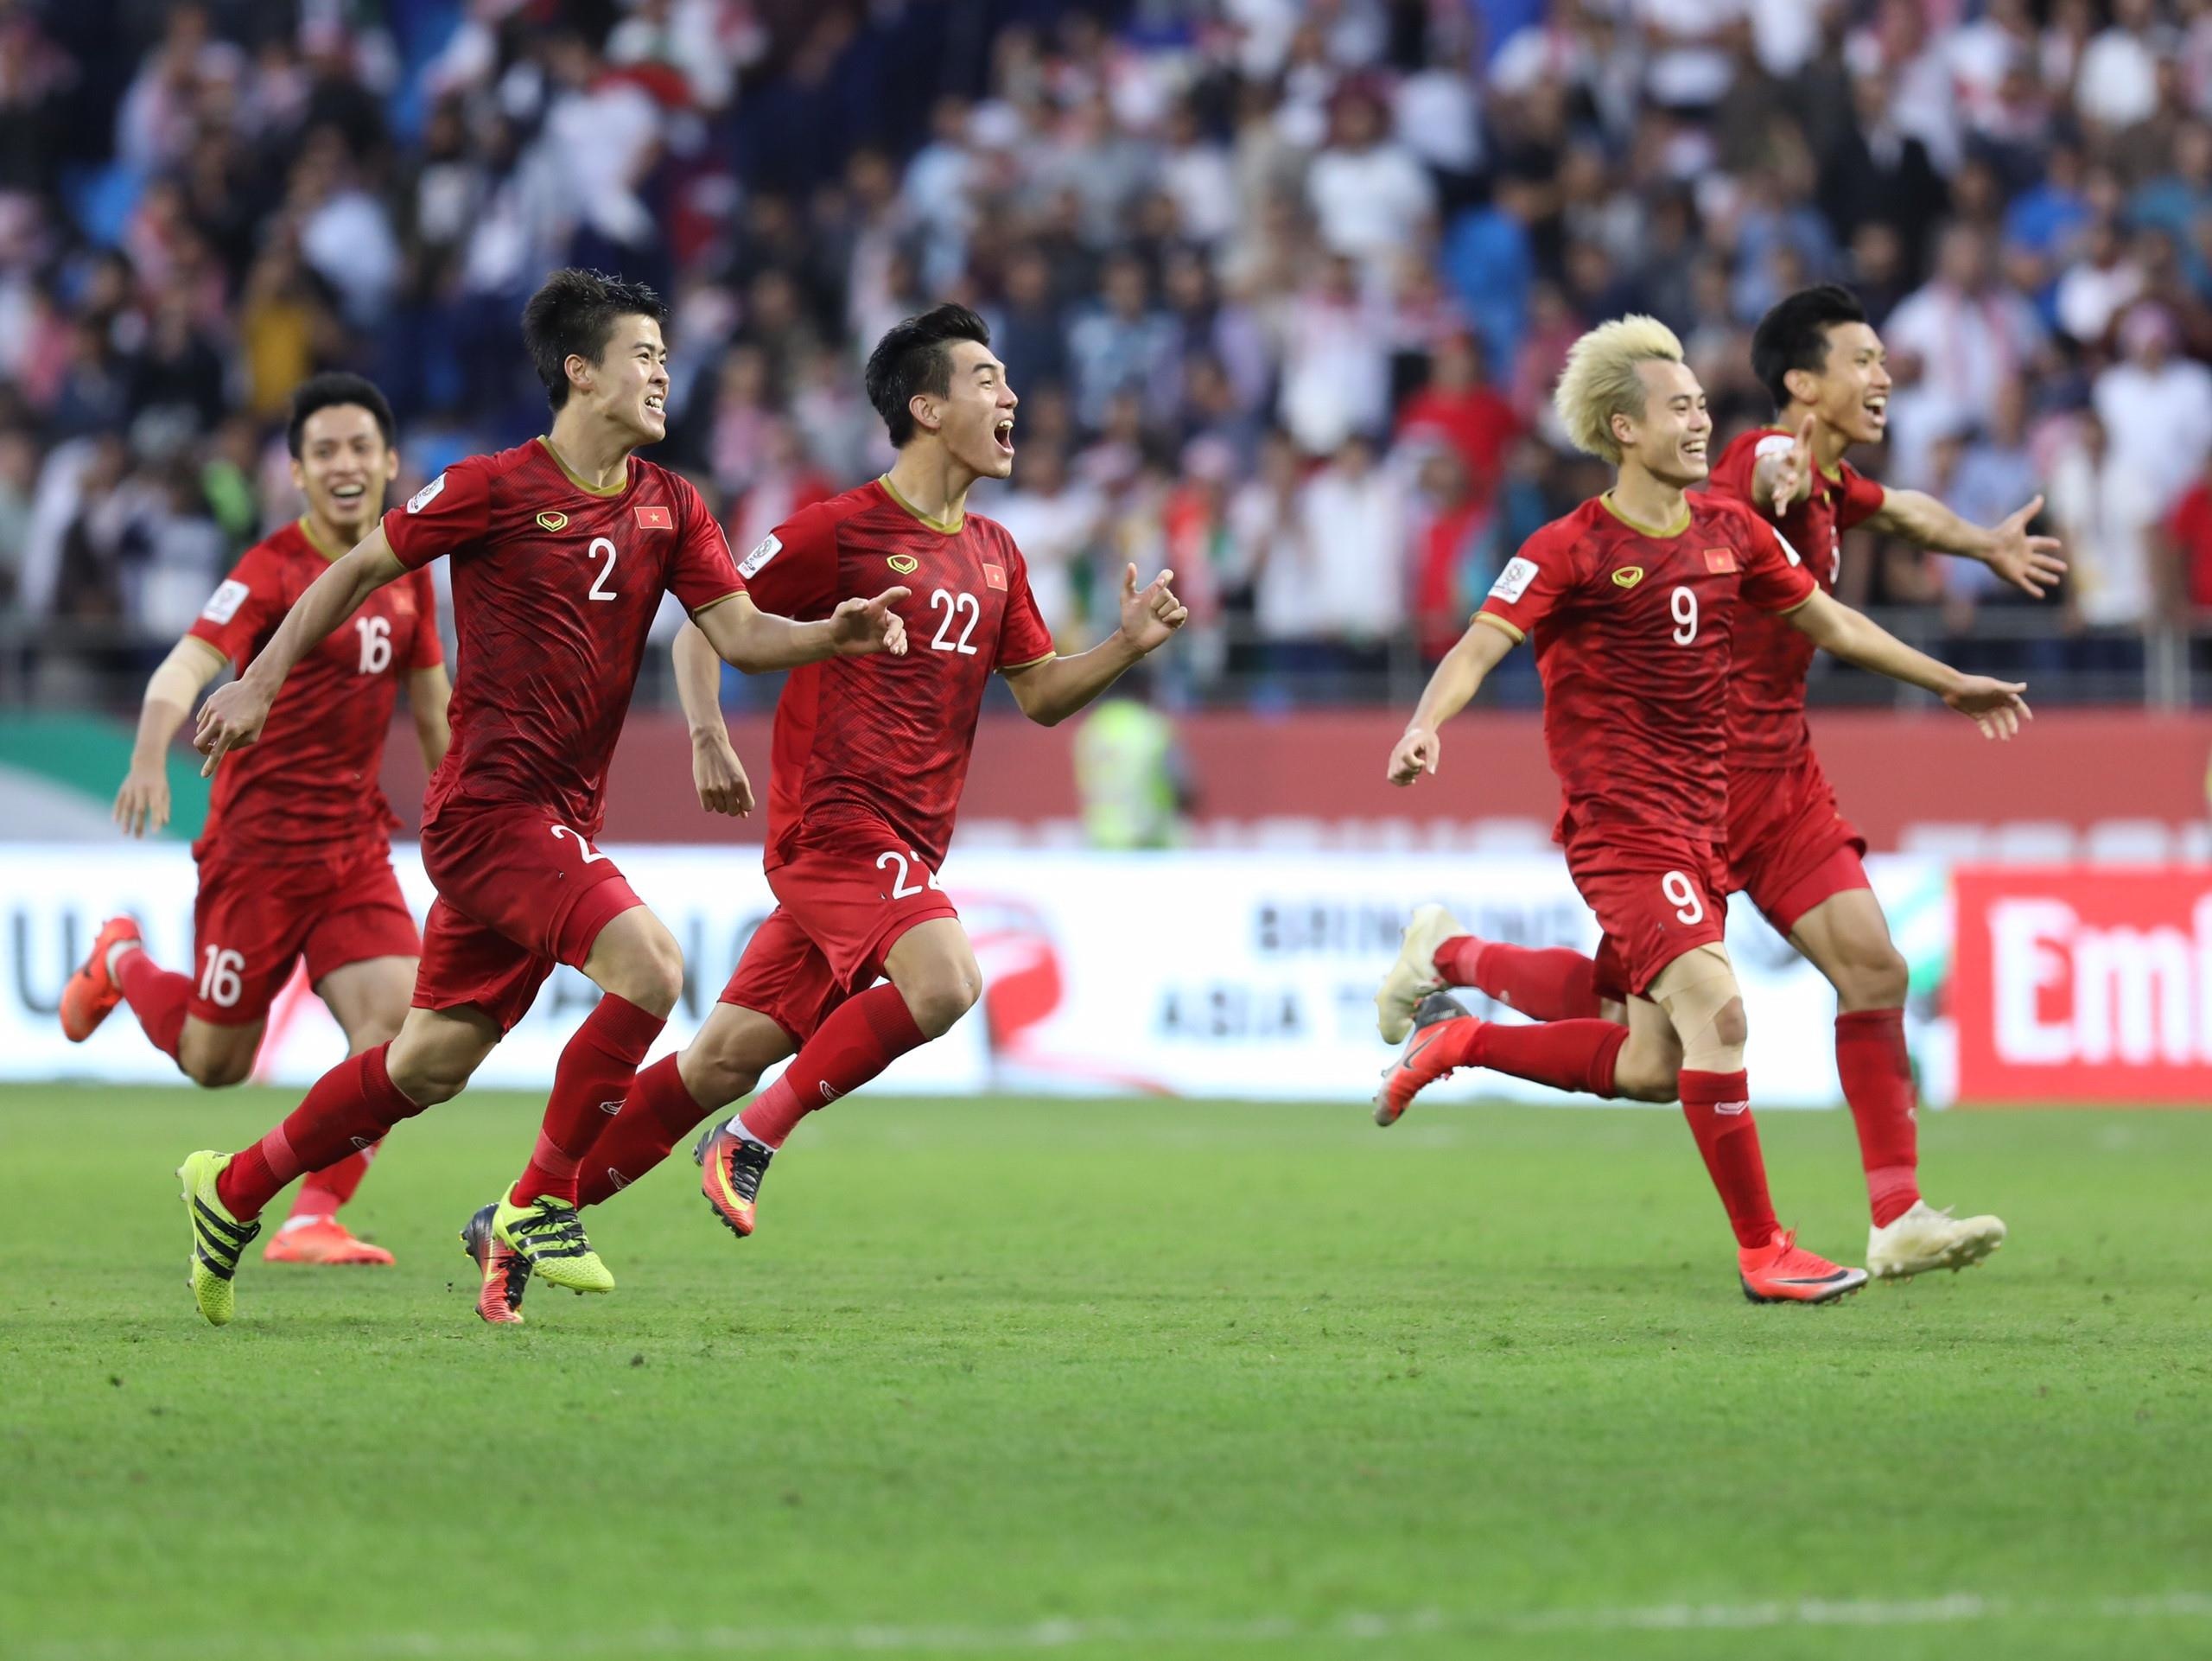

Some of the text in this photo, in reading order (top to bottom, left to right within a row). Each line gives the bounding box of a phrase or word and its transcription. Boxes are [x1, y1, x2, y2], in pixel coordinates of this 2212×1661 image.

[588, 537, 618, 601] 2
[354, 615, 392, 673] 16
[930, 586, 980, 656] 22
[1670, 585, 1698, 646] 9
[550, 824, 607, 864] 2
[1662, 870, 1704, 926] 9
[199, 944, 245, 1007] 16
